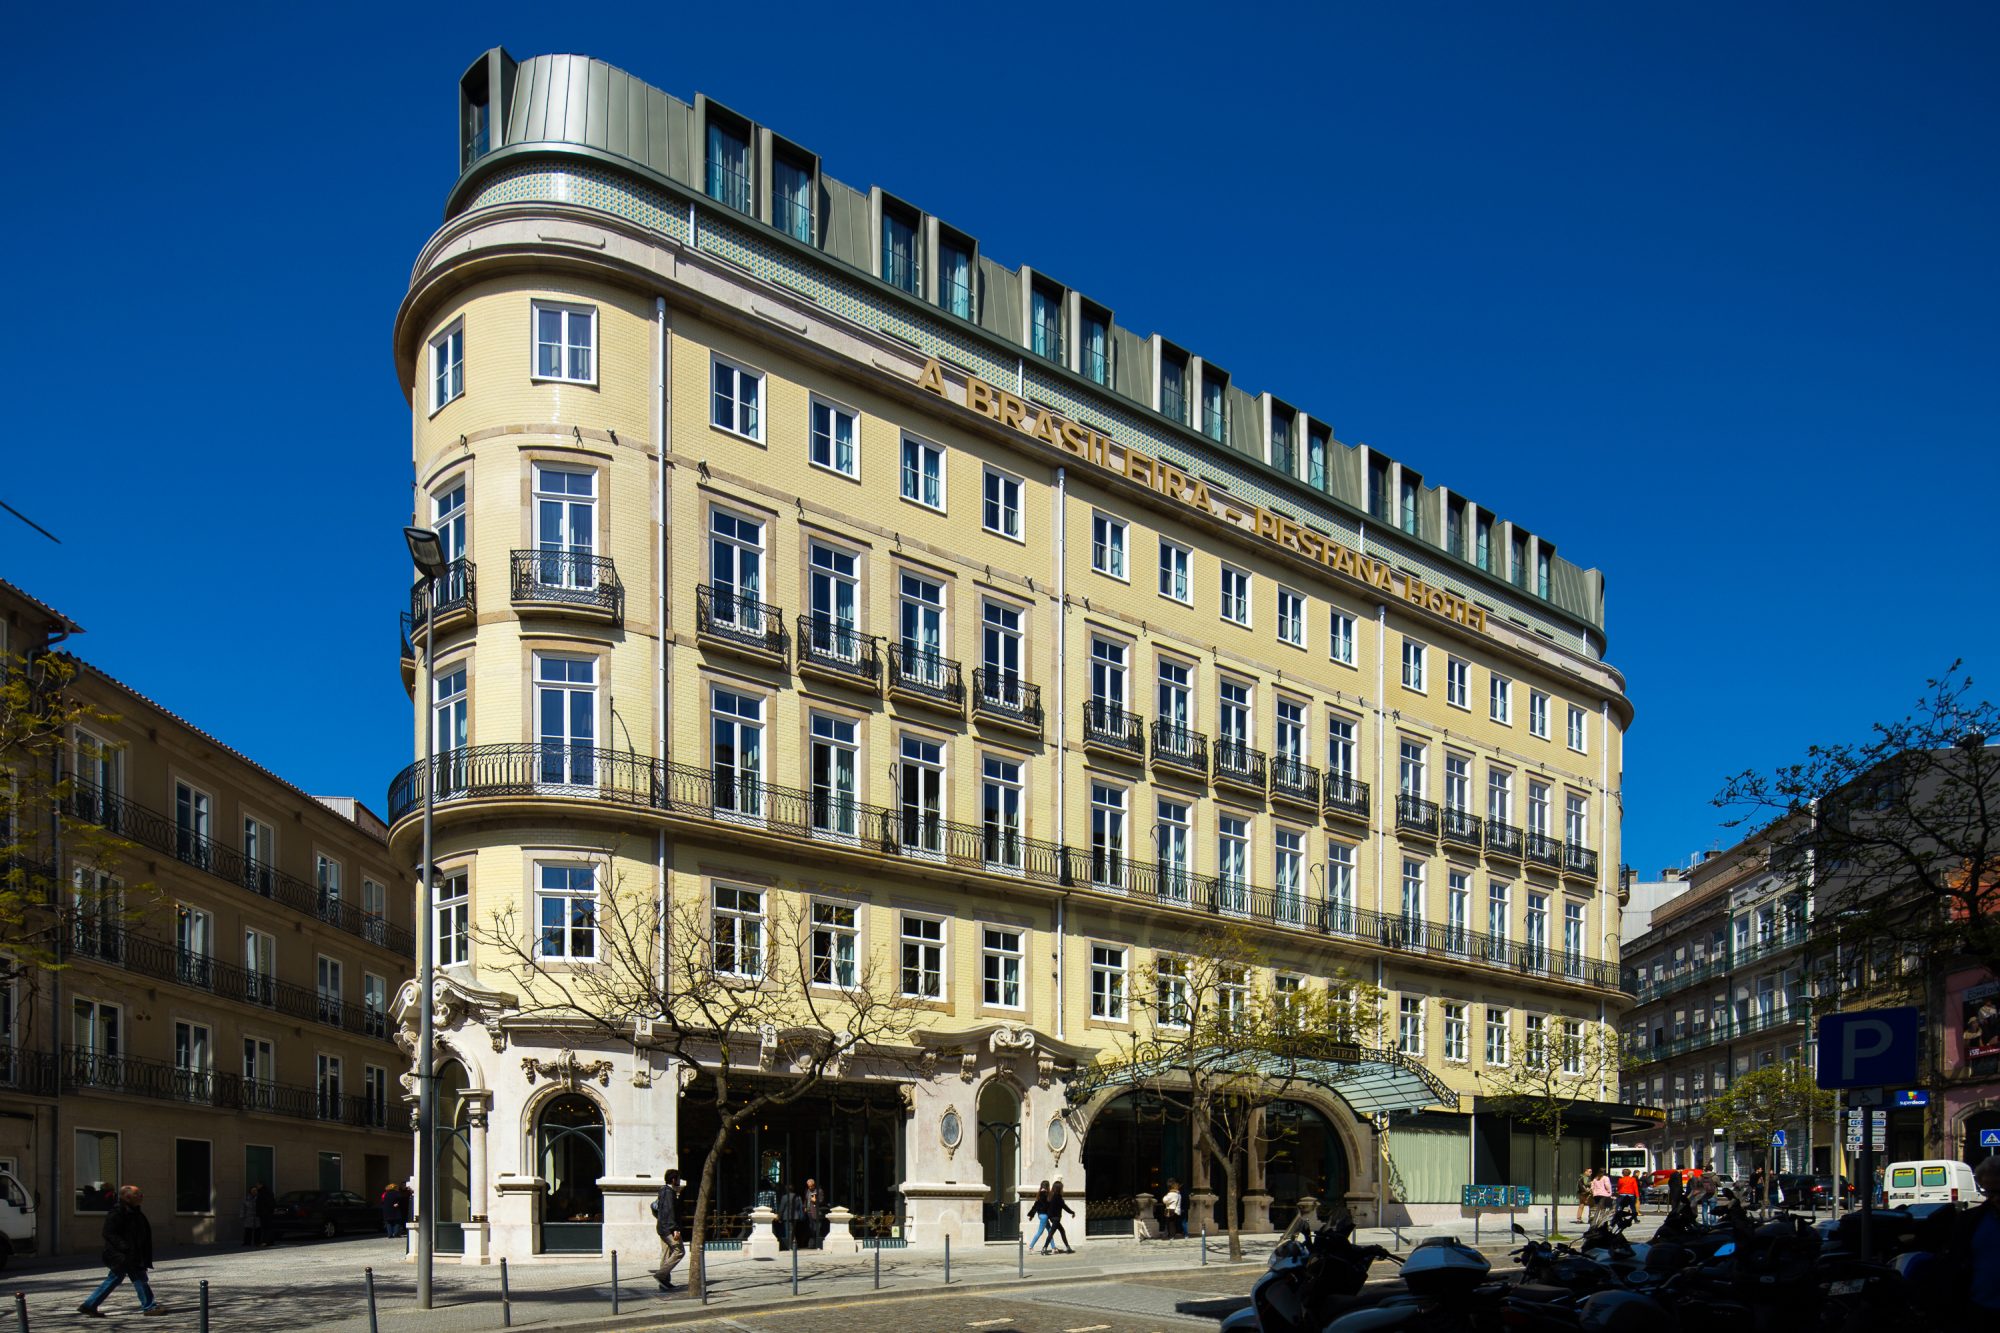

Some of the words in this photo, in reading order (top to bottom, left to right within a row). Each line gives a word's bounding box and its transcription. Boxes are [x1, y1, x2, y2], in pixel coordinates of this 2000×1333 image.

[918, 358, 948, 399] A
[967, 376, 1214, 514] BRASILEIRA
[1255, 506, 1396, 593] PESTANA
[1405, 575, 1494, 637] HOTEL
[1843, 1019, 1893, 1081] P
